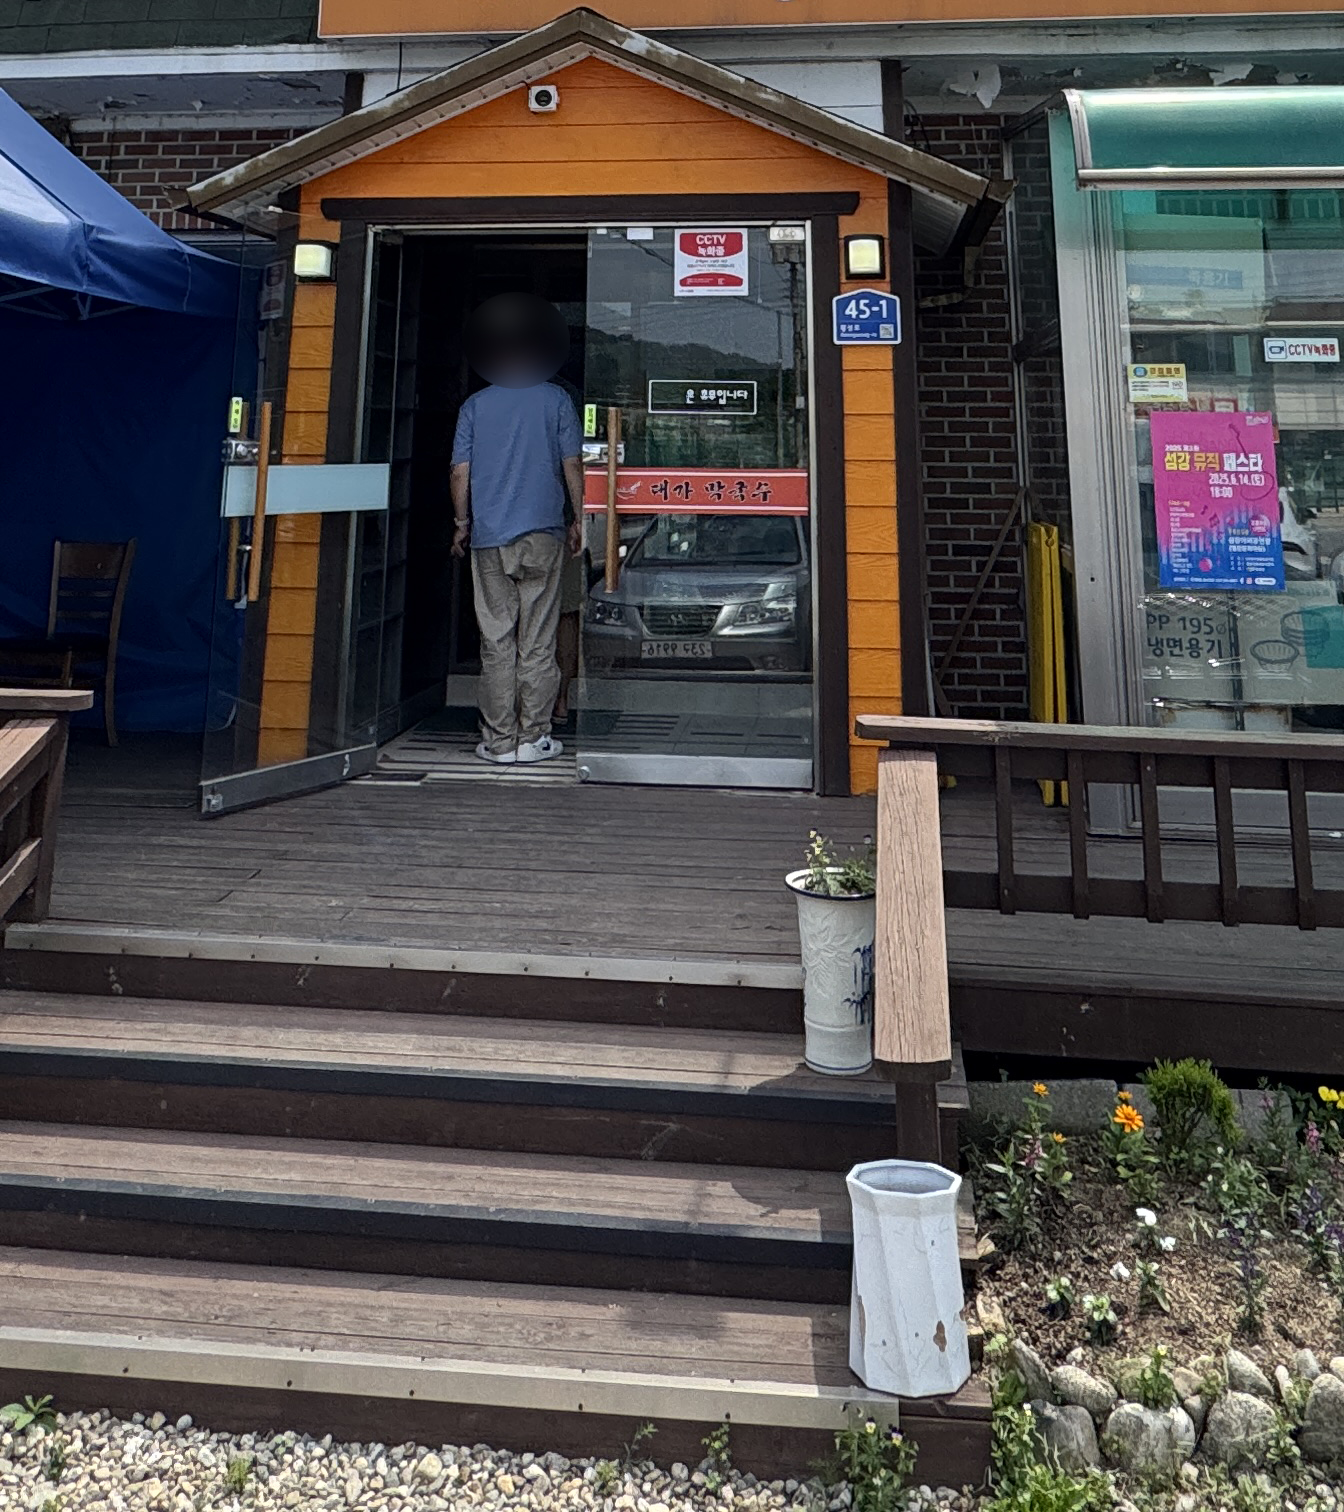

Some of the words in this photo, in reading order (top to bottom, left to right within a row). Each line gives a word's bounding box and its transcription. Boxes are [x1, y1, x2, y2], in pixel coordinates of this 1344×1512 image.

[696, 234, 726, 245] CCTV
[844, 299, 888, 319] 45-1
[685, 389, 694, 404] 은
[1164, 451, 1191, 471] 섬강
[1194, 452, 1220, 472] 뮤직
[1223, 452, 1263, 472] 페스타
[650, 479, 694, 501] 대가
[704, 480, 773, 502] 막국수
[1147, 636, 1223, 659] 냉면용기
